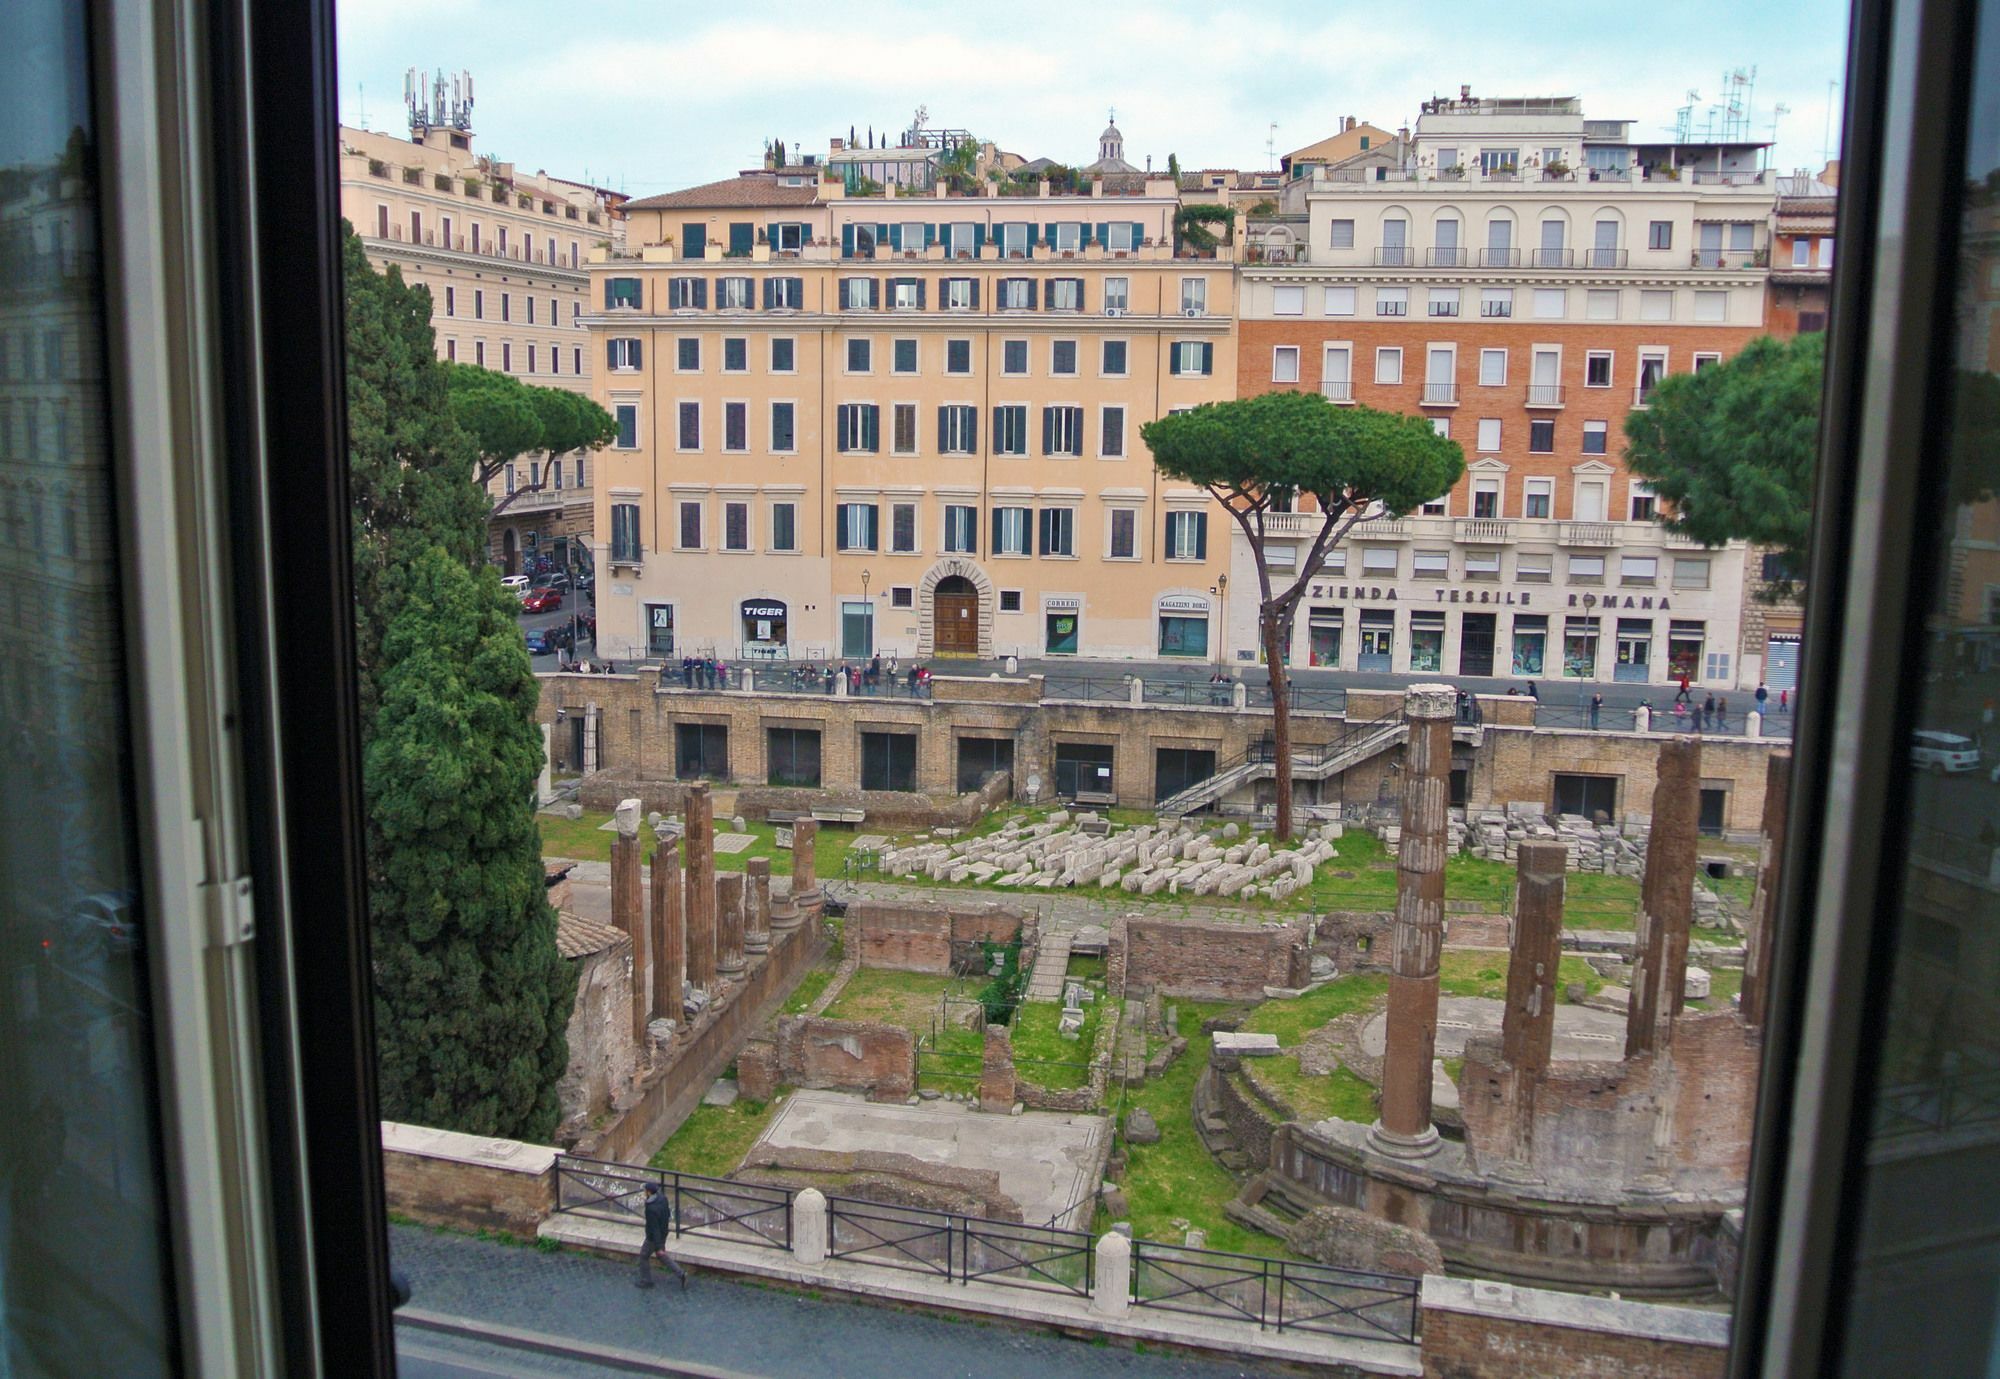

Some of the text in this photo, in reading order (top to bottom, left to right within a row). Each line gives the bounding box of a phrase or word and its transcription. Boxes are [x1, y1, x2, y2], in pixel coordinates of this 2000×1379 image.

[1302, 585, 1398, 601] ZIENDA
[1435, 589, 1531, 605] TESSILE
[744, 607, 783, 616] TIGER
